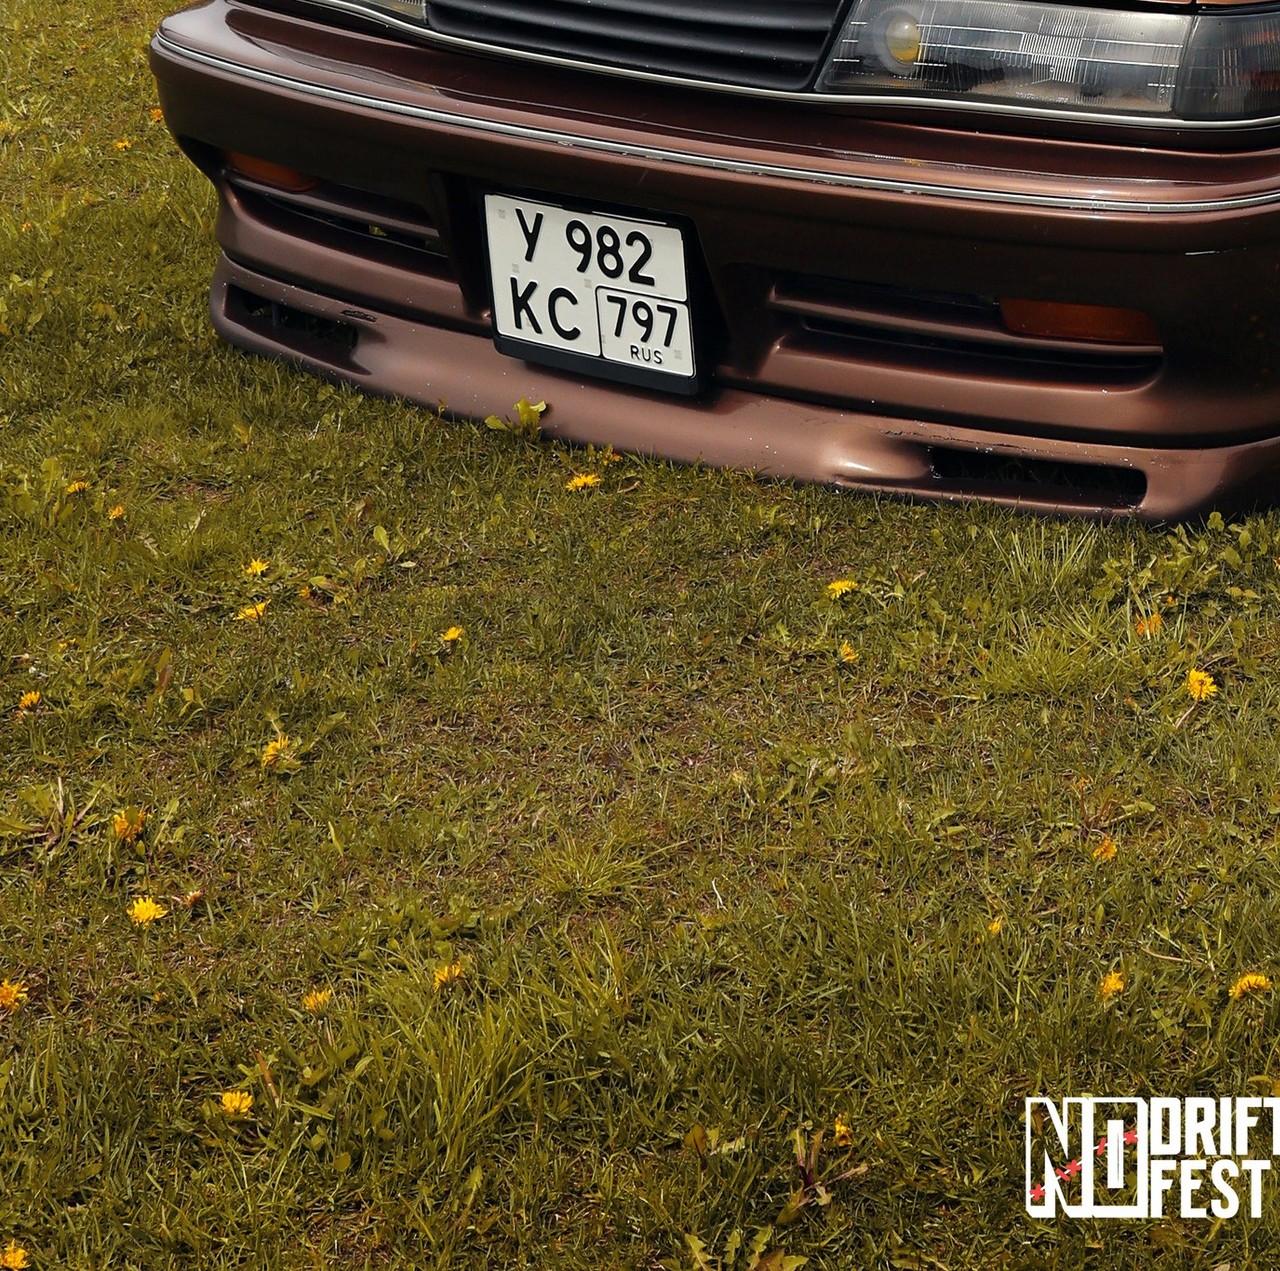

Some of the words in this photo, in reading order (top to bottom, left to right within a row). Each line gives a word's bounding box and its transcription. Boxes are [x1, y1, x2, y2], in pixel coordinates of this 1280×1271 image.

[565, 219, 656, 286] 982
[606, 295, 678, 348] 797
[630, 344, 663, 365] RUS
